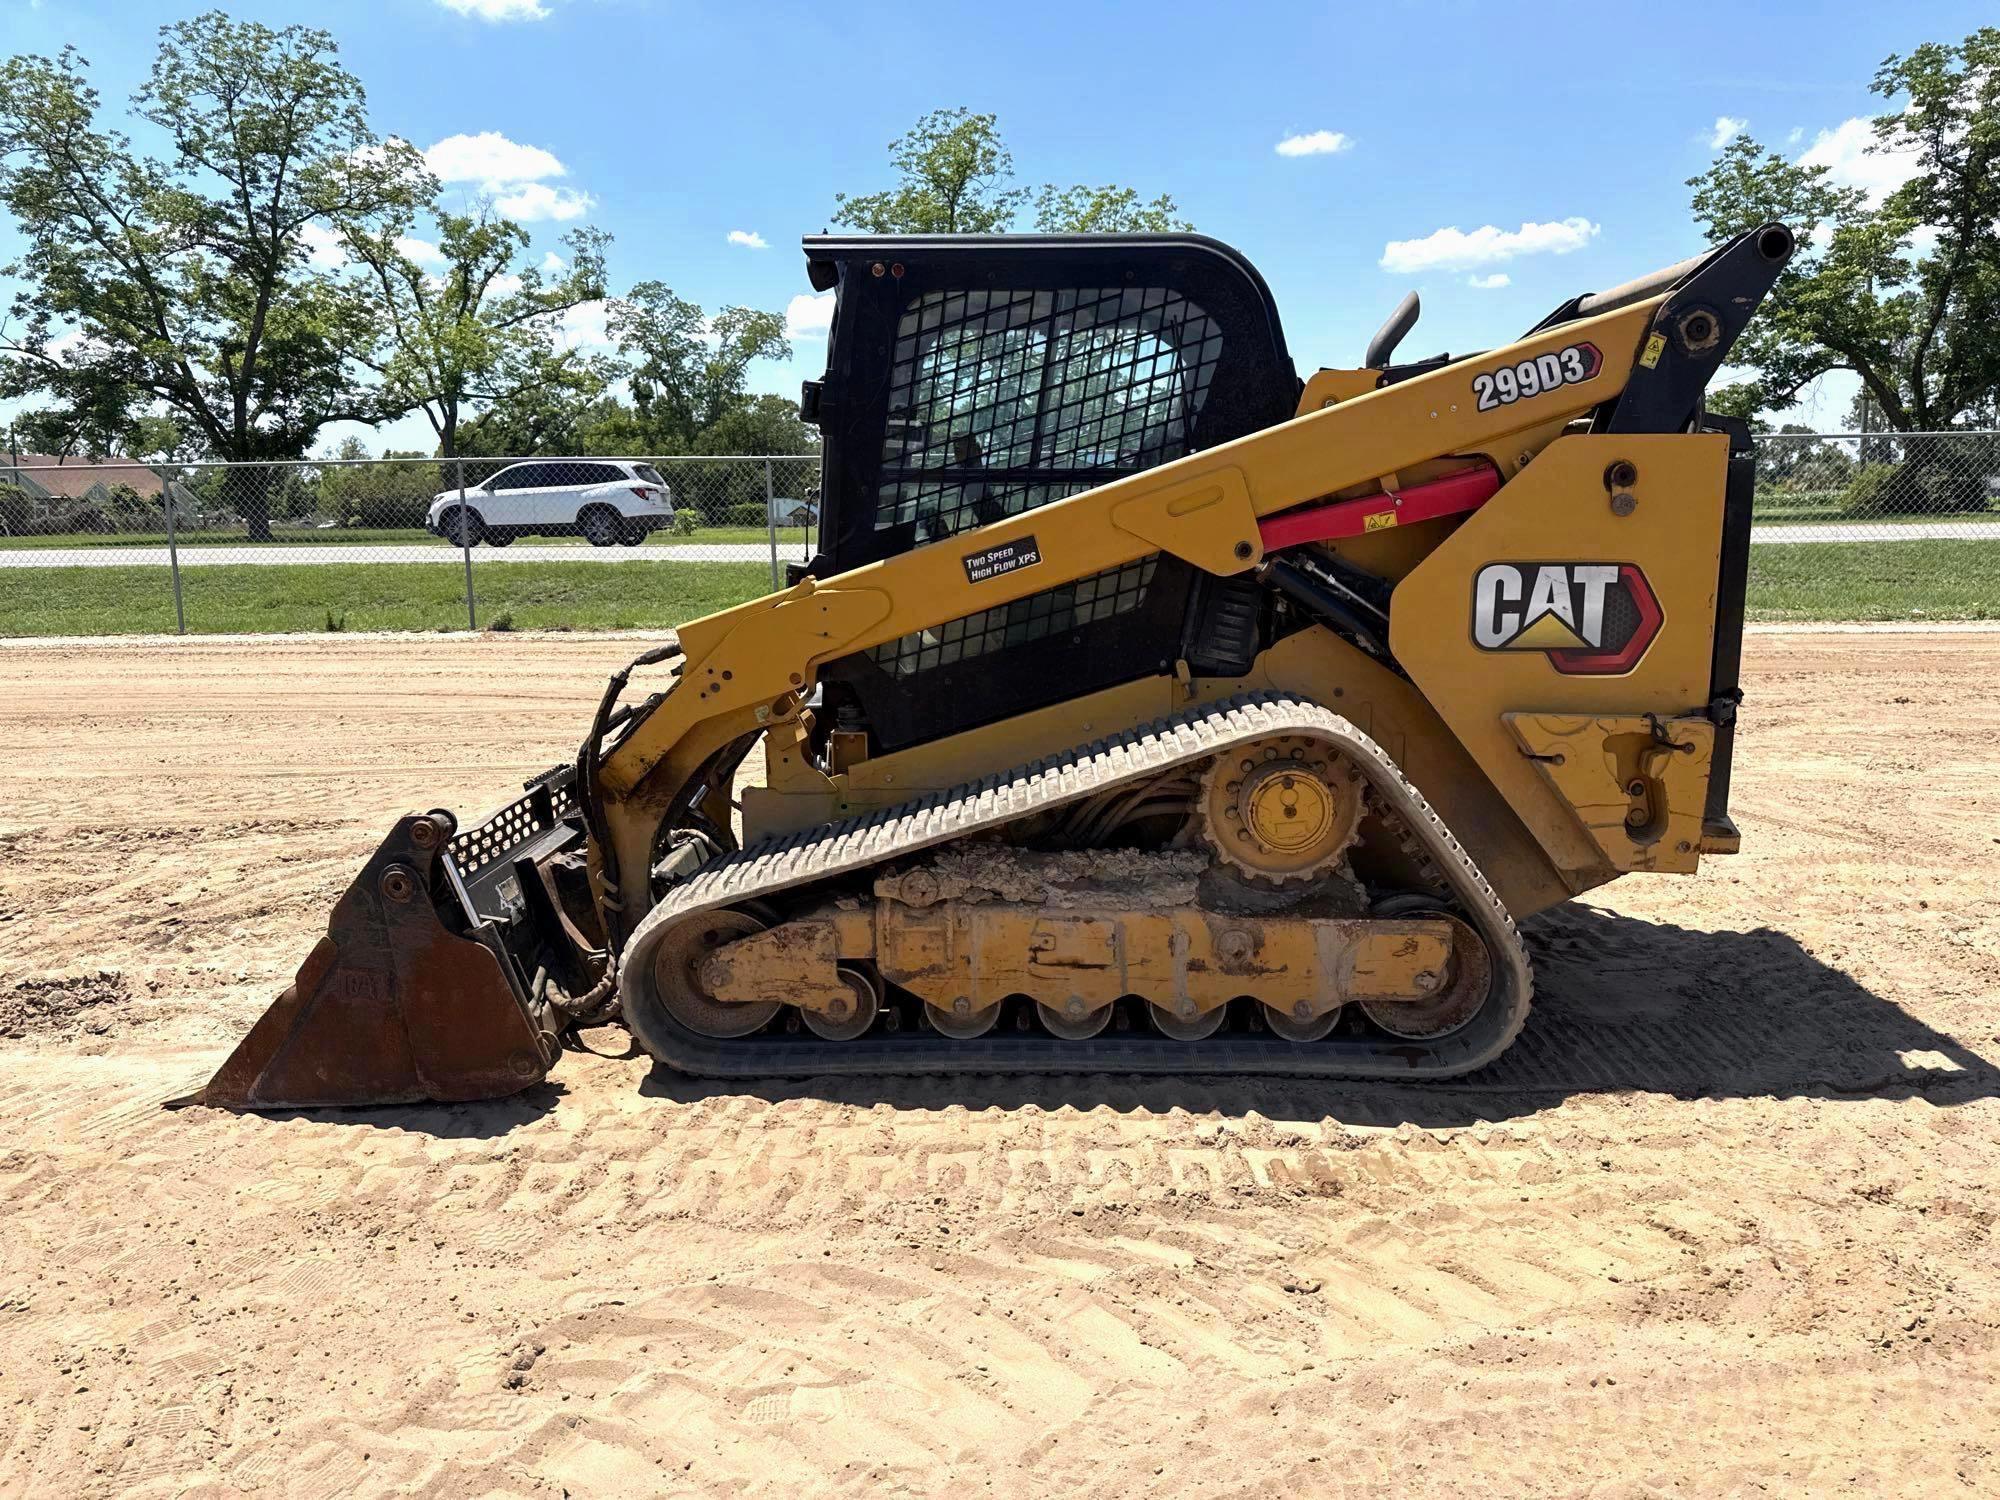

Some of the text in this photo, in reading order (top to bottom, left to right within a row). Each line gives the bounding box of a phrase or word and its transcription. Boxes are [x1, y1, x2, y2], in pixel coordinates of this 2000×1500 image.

[1473, 347, 1585, 411] 299D3
[966, 547, 1014, 569] TWO SPEED
[971, 552, 1037, 580] HIGH FLOW XPS
[1474, 564, 1619, 648] CAT
